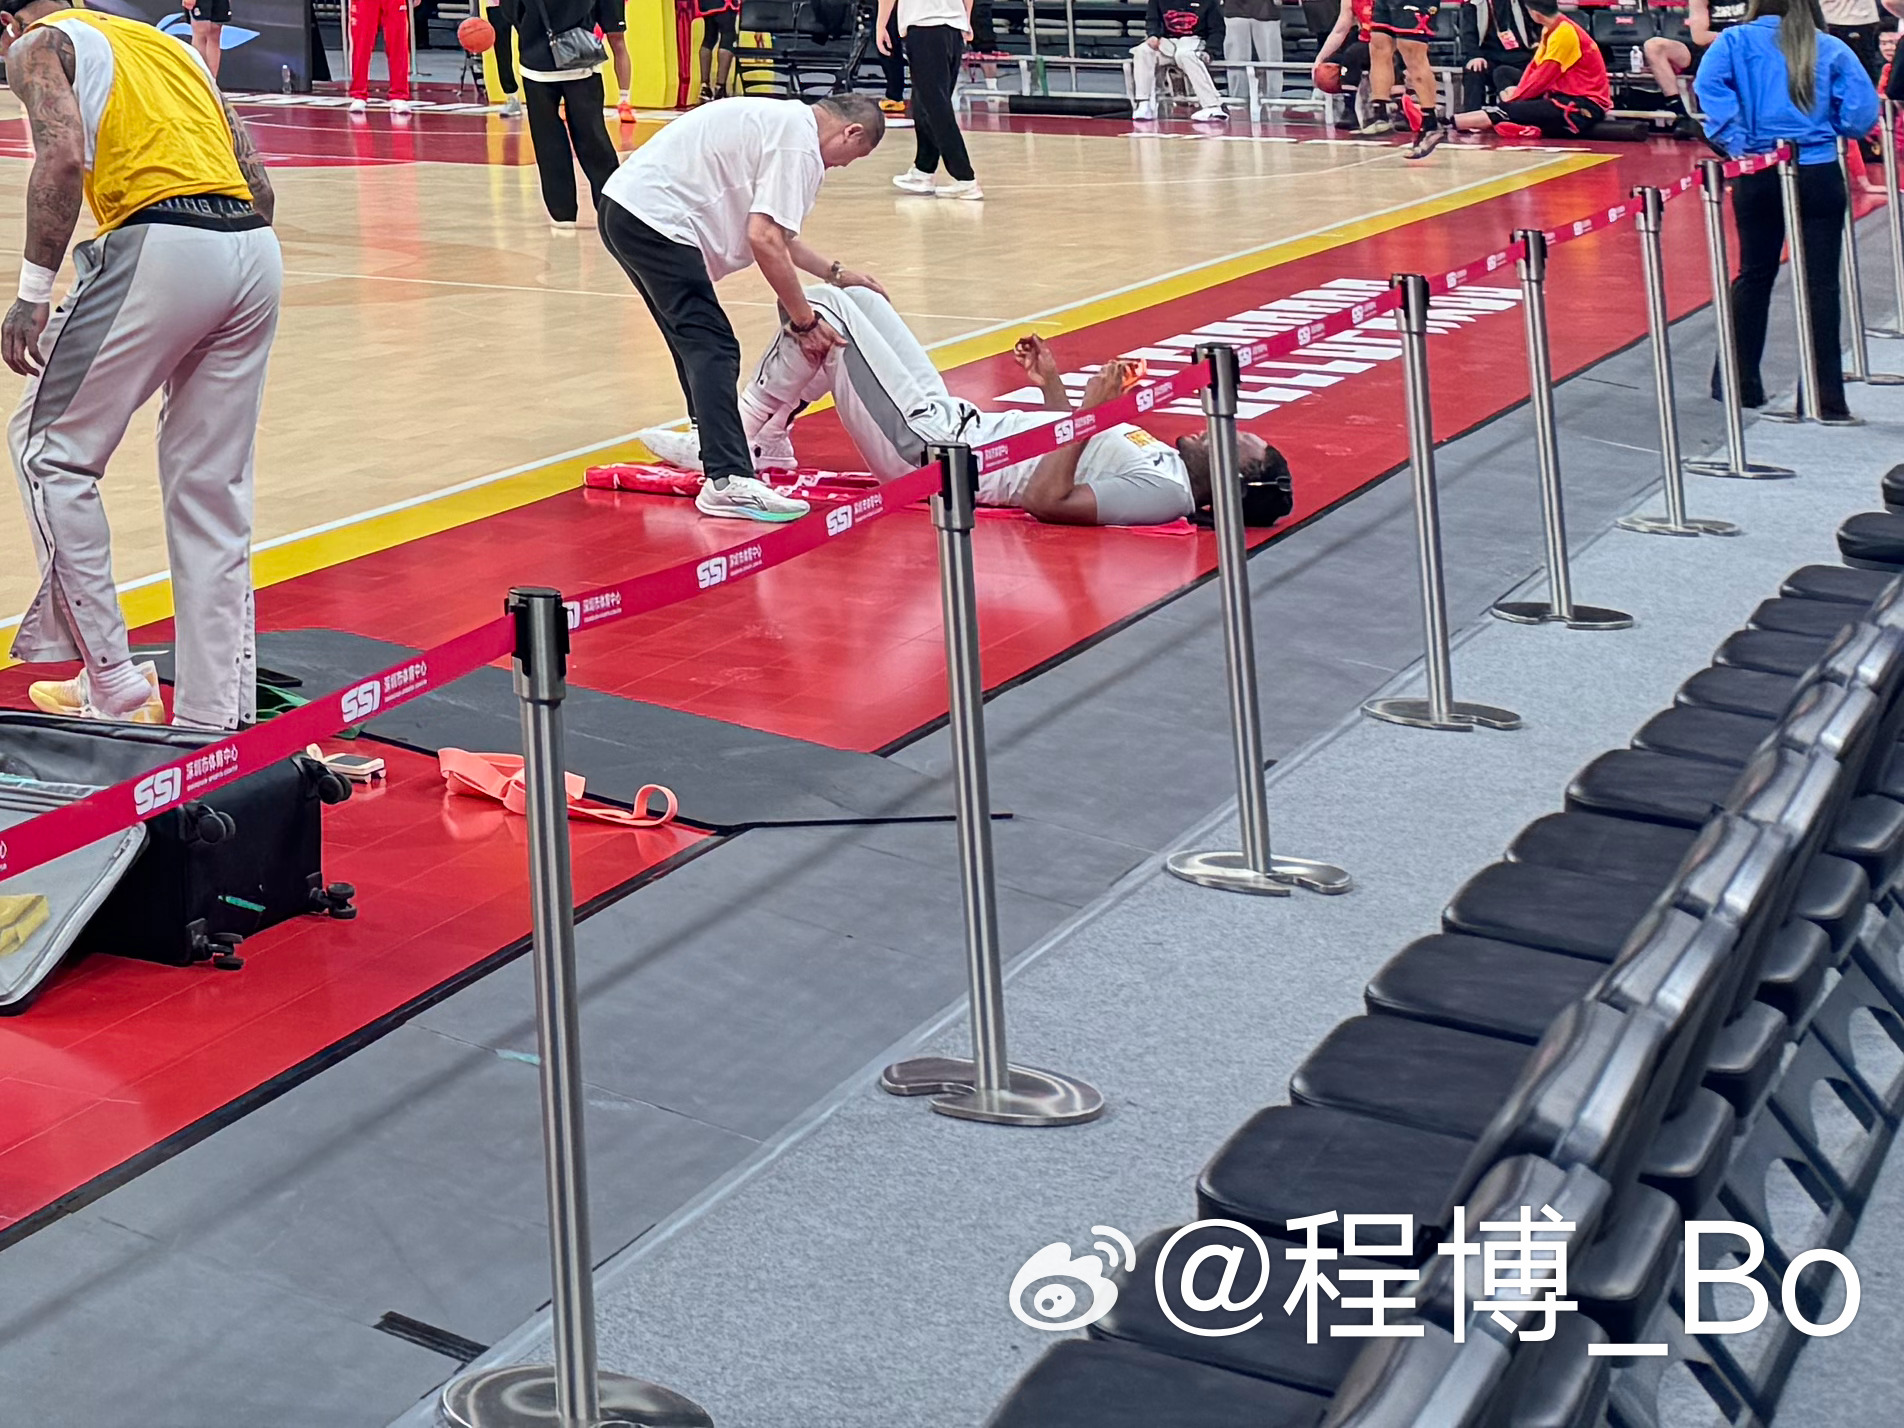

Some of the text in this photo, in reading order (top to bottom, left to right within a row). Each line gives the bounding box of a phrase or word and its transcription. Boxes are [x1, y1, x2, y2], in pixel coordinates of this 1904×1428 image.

[825, 505, 853, 537] SSI
[696, 556, 727, 590] SSI
[341, 680, 381, 723] SSI
[134, 766, 182, 816] SSI
